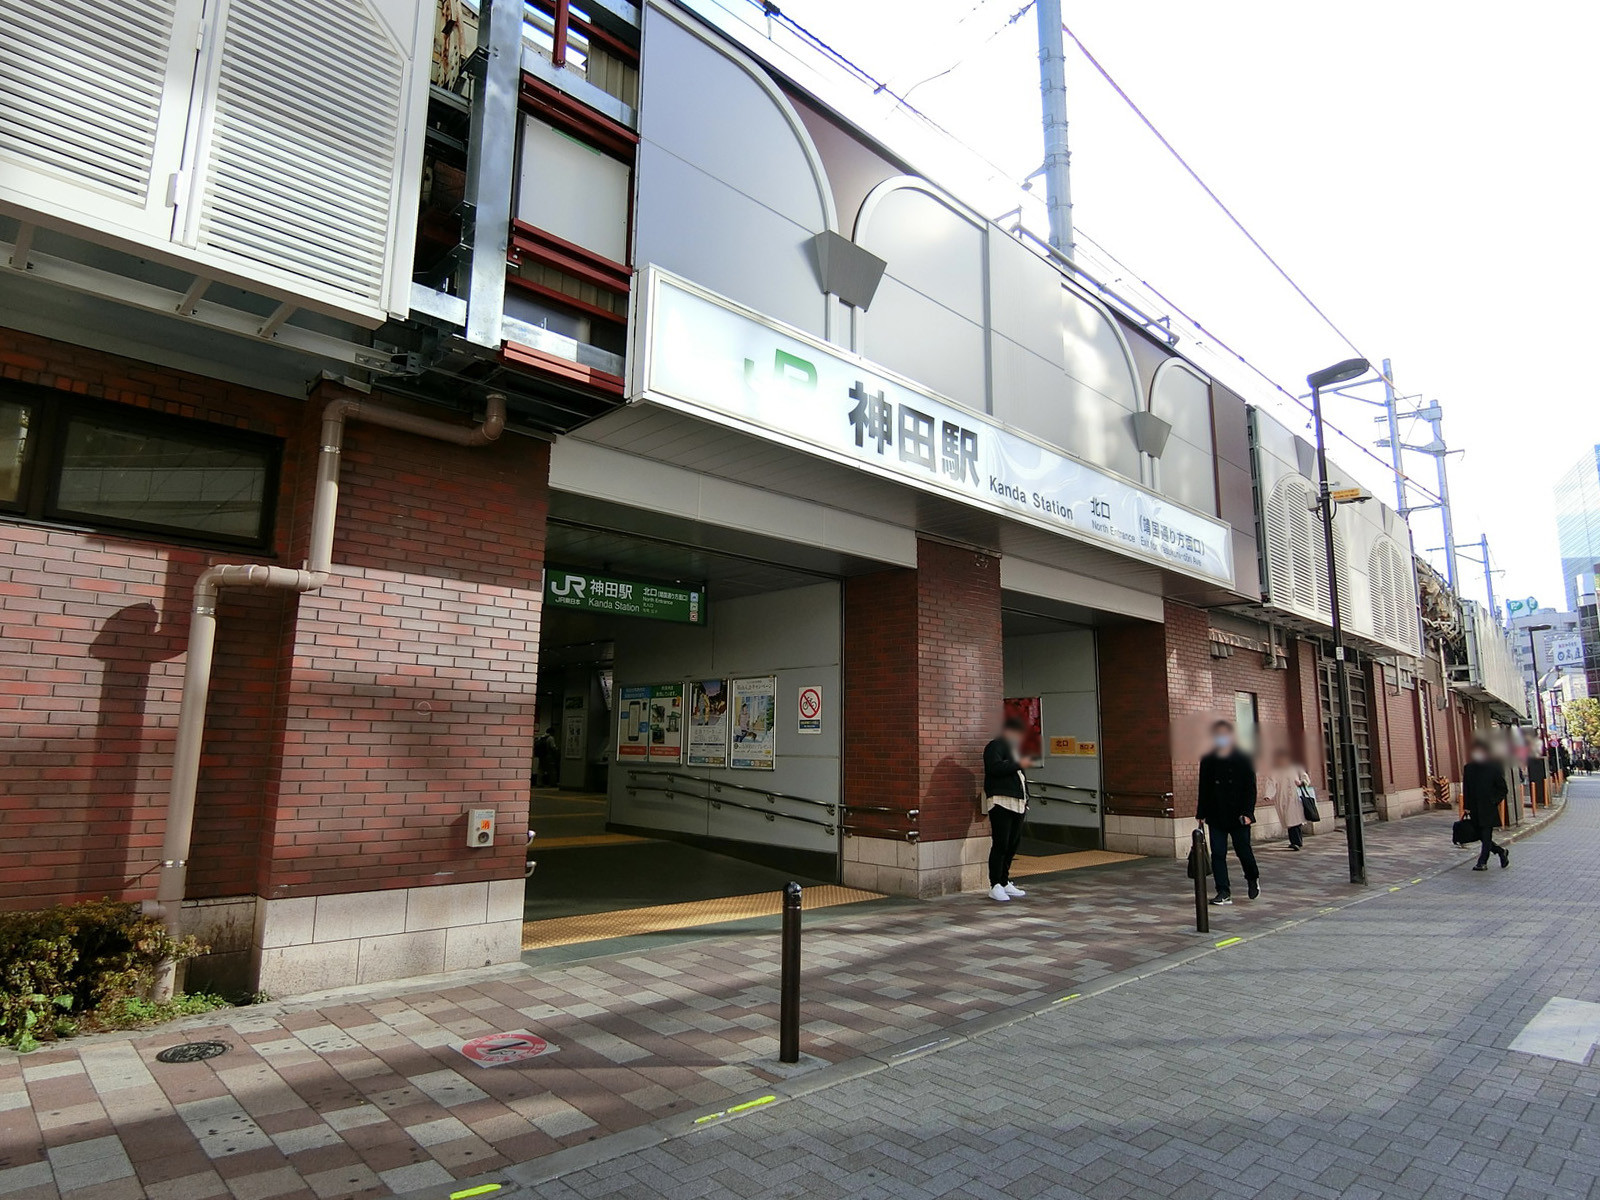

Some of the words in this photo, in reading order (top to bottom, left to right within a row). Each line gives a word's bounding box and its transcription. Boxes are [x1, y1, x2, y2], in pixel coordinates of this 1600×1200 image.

[848, 380, 980, 487] 神田駅
[989, 475, 1027, 504] Kanda
[1033, 492, 1073, 521] Station
[1090, 497, 1110, 520] 北口
[1091, 519, 1109, 534] North
[551, 575, 586, 598] JR
[589, 579, 633, 600] 神田駅
[643, 587, 657, 597] 北口
[554, 597, 581, 605] JR東日本
[588, 597, 613, 609] Kanda
[614, 601, 640, 612] Station
[655, 598, 673, 606] Entrance
